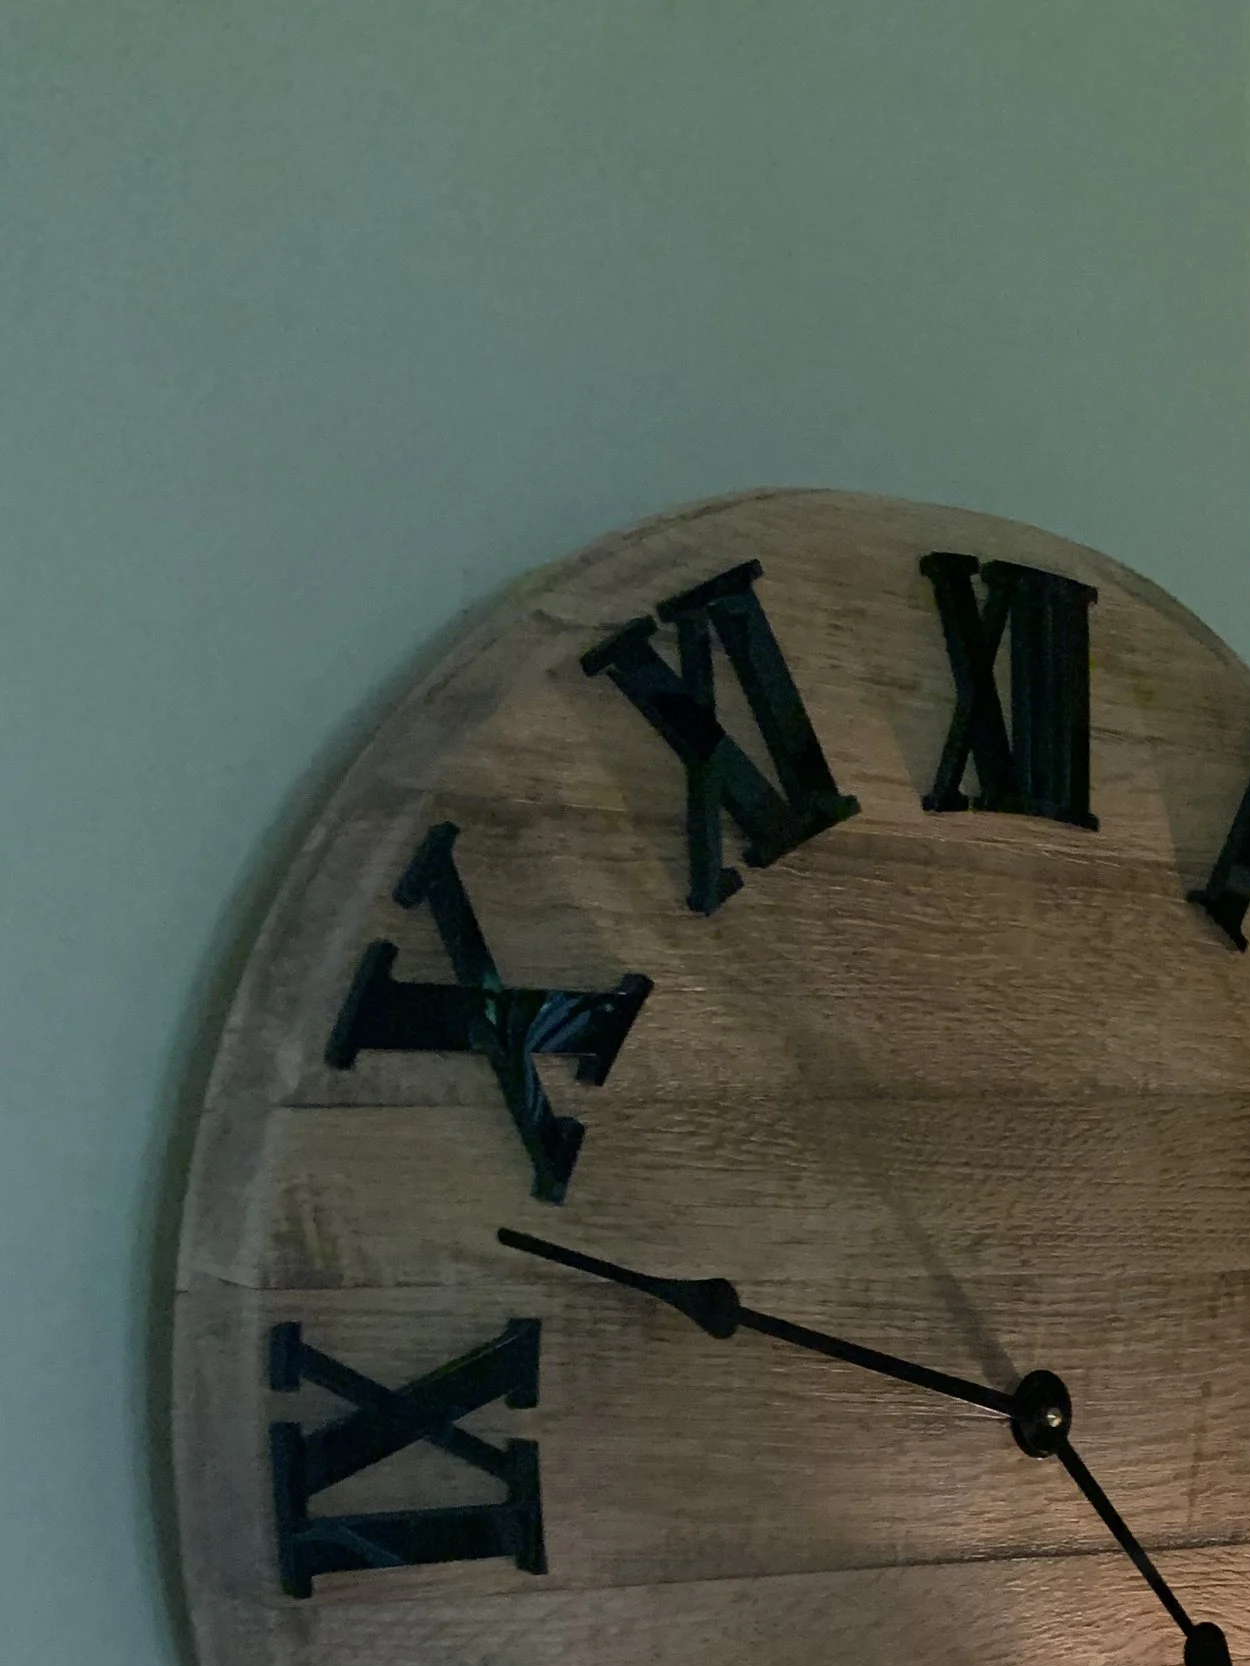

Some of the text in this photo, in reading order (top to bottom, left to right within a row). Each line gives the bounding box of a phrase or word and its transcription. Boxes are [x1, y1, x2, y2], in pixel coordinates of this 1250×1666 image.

[581, 557, 860, 915] XI
[922, 551, 1100, 832] XII
[324, 822, 654, 1203] X
[268, 1316, 545, 1598] IX
